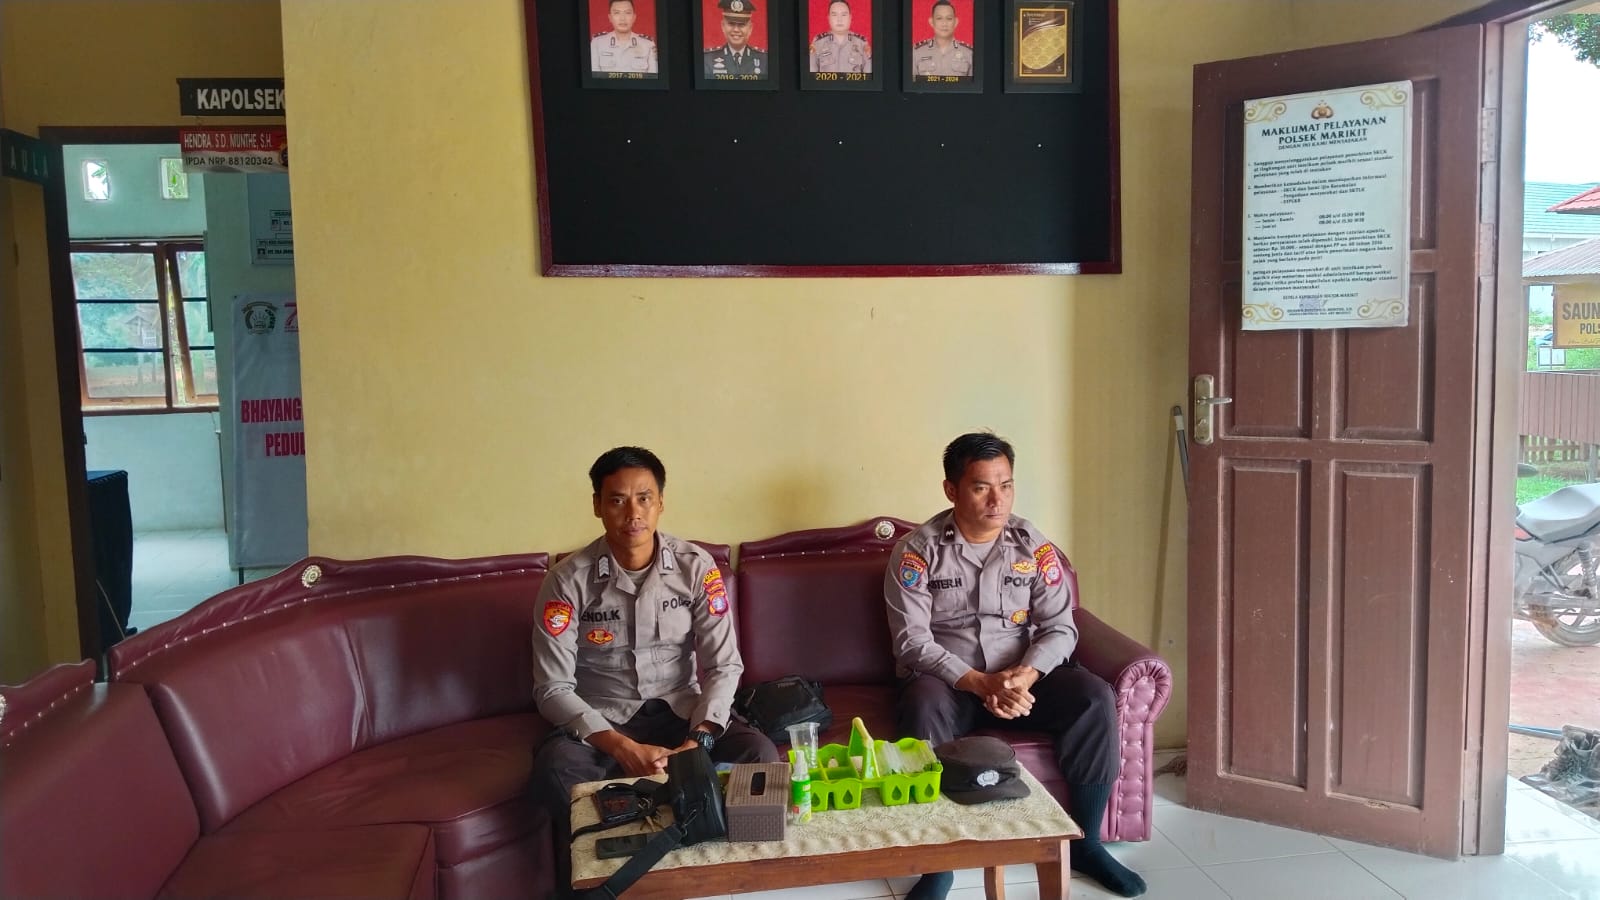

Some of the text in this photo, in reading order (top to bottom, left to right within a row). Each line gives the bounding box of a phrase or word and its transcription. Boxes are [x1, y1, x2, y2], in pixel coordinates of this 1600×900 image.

[816, 73, 838, 81] 2020
[846, 73, 867, 81] 2021
[197, 88, 286, 110] KAPOLSEK
[1261, 116, 1387, 137] MAKLUMAT PELAYANAN
[1278, 128, 1368, 145] POLSEK MARIKIT
[10, 144, 49, 179] AULA
[185, 157, 273, 166] IPDA NRP 88120342
[1562, 302, 1600, 320] SAUN
